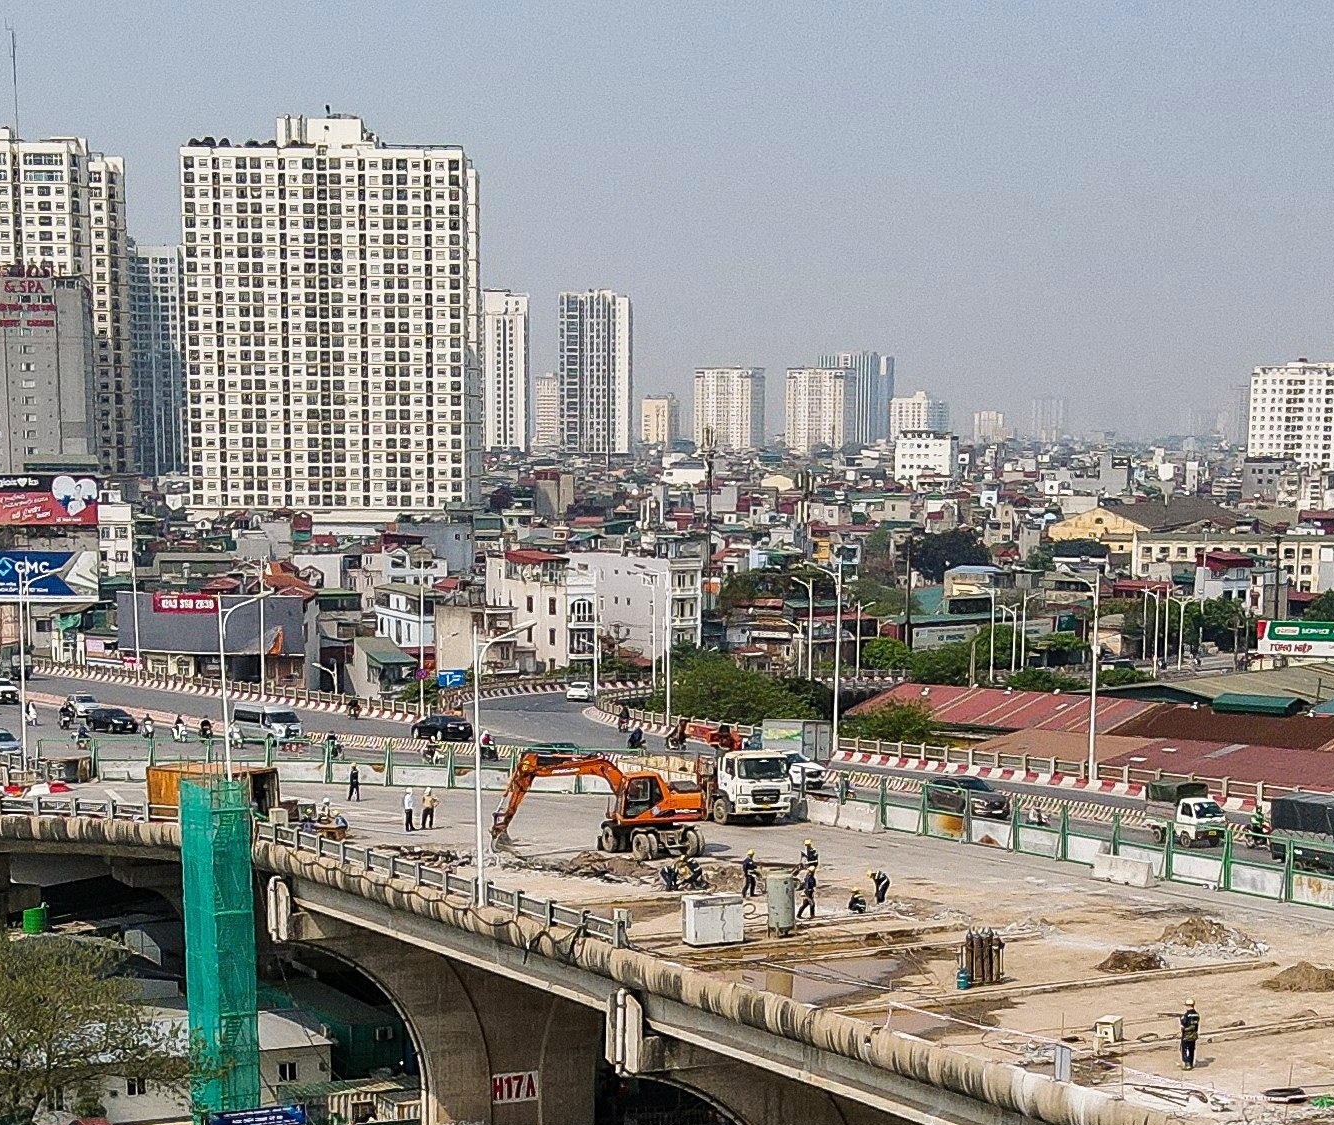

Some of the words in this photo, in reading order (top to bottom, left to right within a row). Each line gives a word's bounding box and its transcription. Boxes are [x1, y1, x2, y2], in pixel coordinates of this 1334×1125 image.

[19, 280, 46, 293] SPA
[14, 561, 50, 574] CMC
[492, 1073, 536, 1100] H17A
